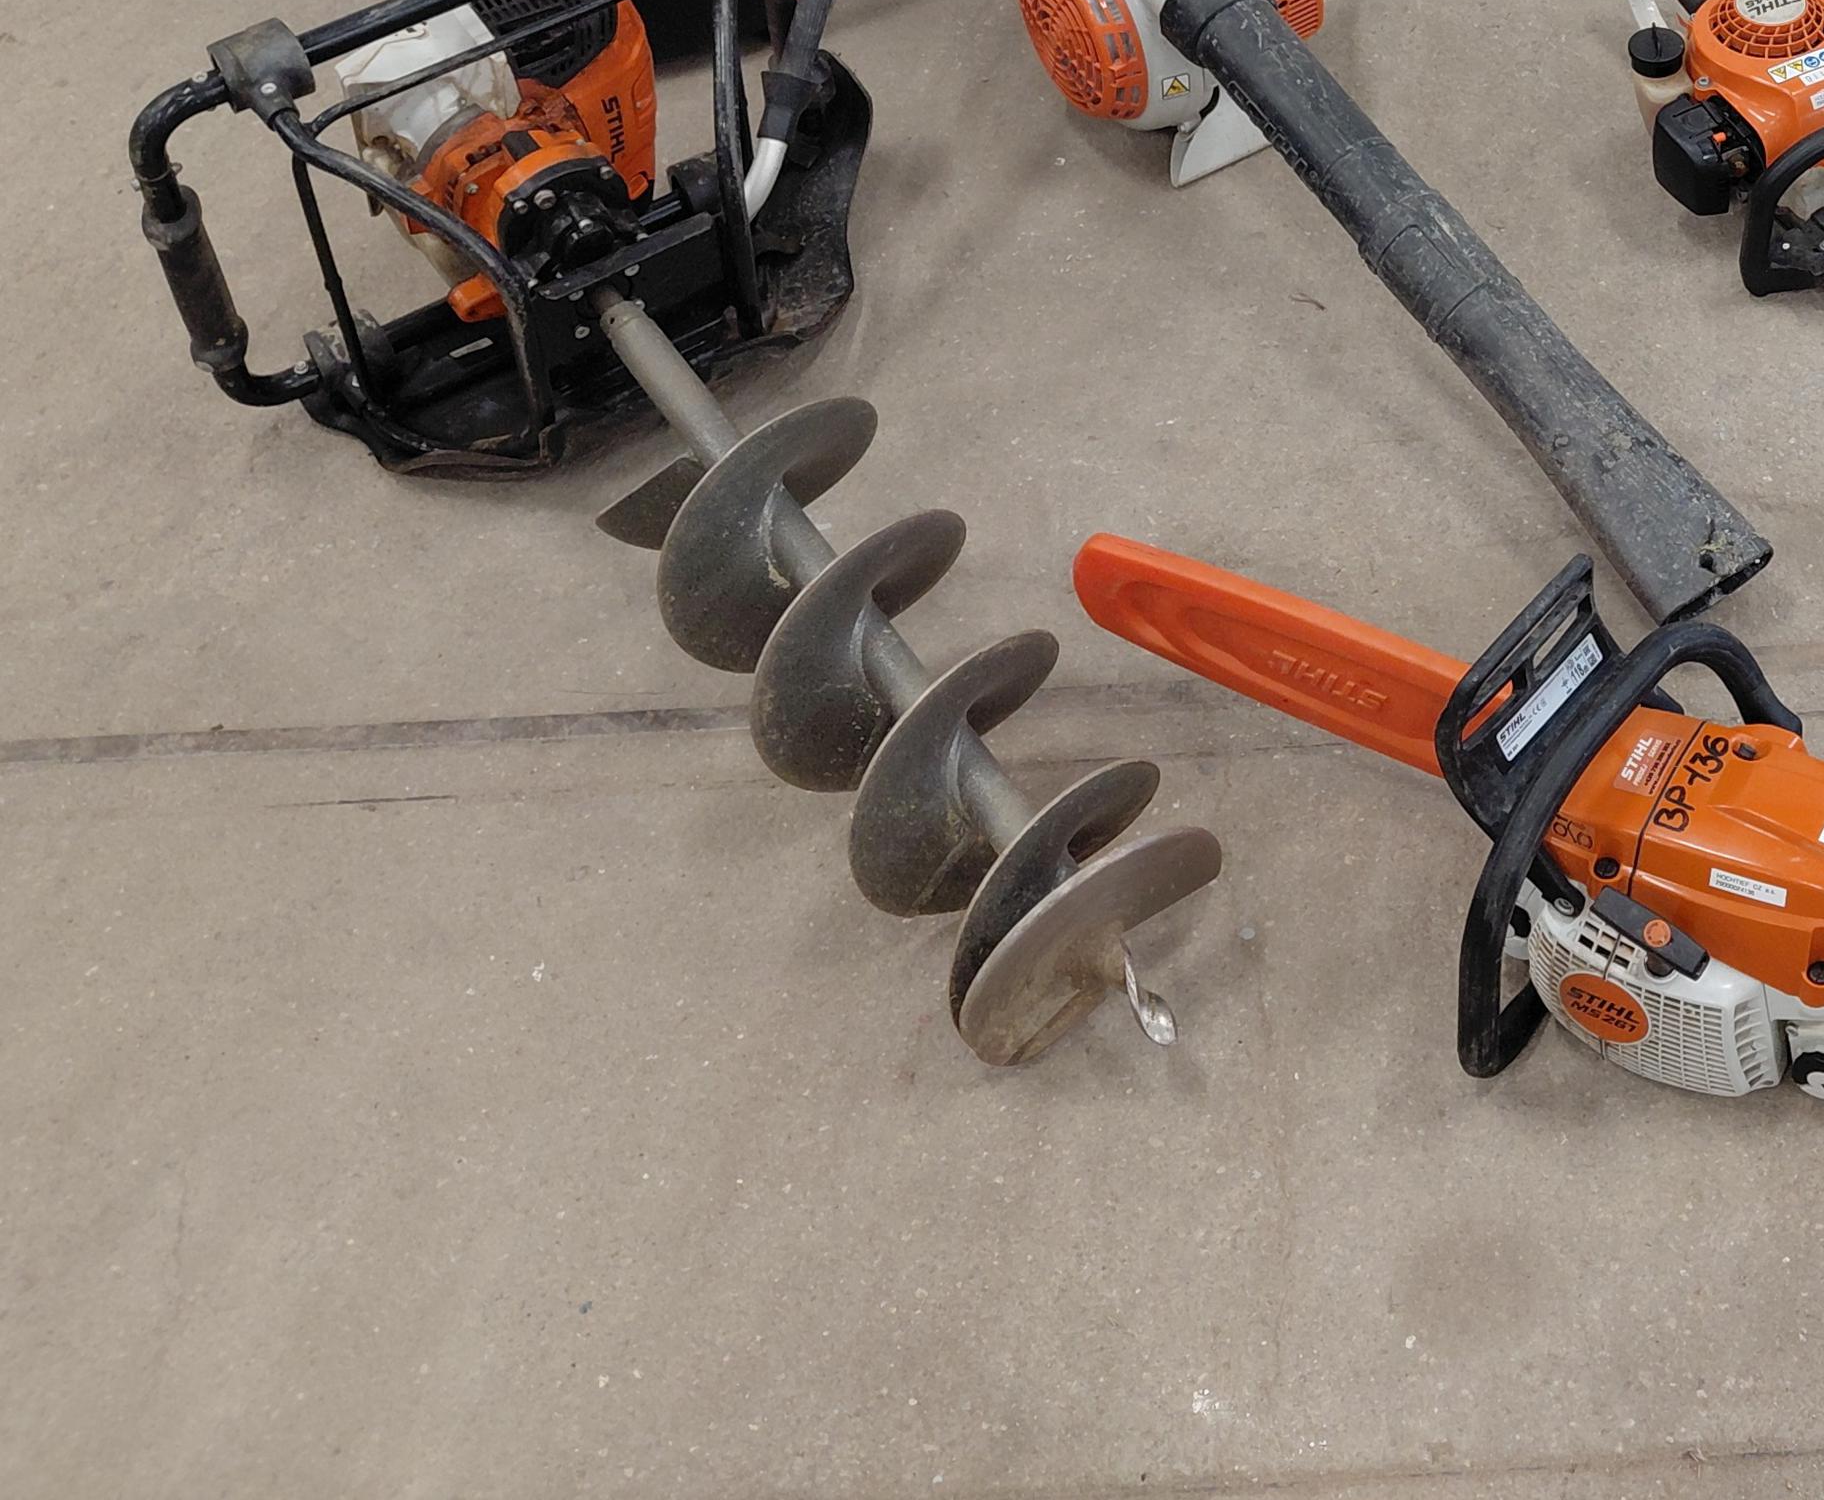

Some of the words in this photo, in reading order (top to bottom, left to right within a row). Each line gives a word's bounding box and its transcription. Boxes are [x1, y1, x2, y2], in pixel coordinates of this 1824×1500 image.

[600, 95, 625, 163] STIHL
[1500, 713, 1526, 743] STIHL
[1621, 737, 1653, 781] STIHL
[1567, 986, 1640, 1025] STIHL
[1571, 1000, 1602, 1019] MS
[1602, 1014, 1637, 1033] 261
